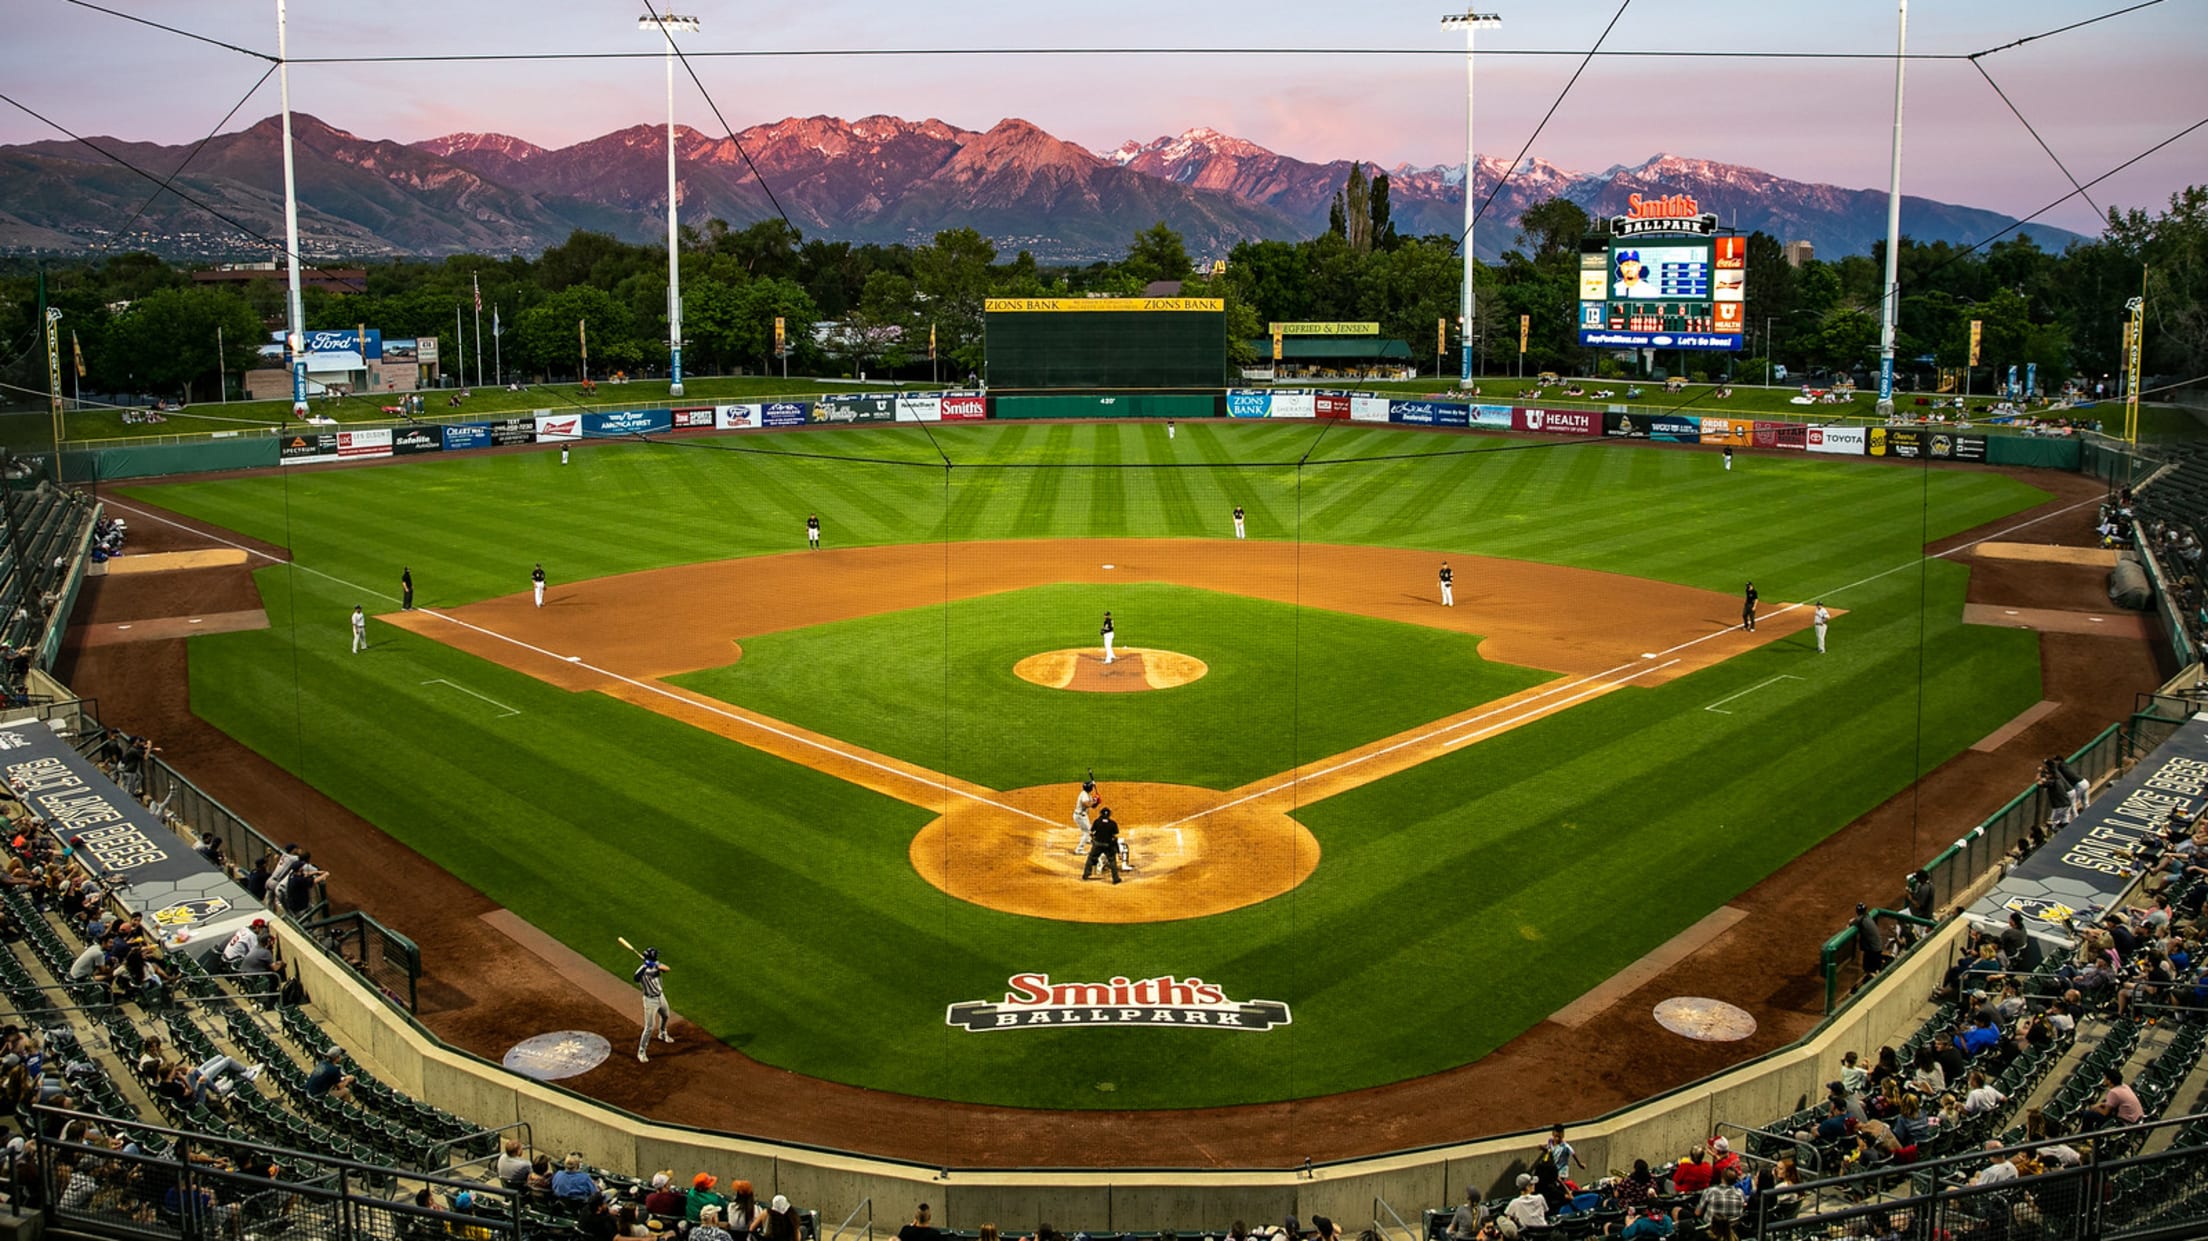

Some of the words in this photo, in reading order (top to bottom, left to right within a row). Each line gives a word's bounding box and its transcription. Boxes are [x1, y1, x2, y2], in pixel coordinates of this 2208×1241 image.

[1627, 193, 1698, 218] Smith's
[1624, 220, 1702, 234] BALLPARK
[986, 300, 1024, 310] ZIONS
[1027, 300, 1060, 310] BANK
[1144, 300, 1181, 310] ZIONS
[1184, 300, 1218, 309] BANK
[1324, 324, 1333, 333] &
[1336, 323, 1370, 333] JENSEN
[311, 332, 352, 350] Ford
[1698, 337, 1709, 346] Go
[1882, 361, 1890, 378] ZONE
[1880, 379, 1888, 399] FORD
[1234, 397, 1264, 405] ZIONS
[943, 401, 984, 416] Smith's
[1234, 405, 1263, 415] BANK
[631, 418, 652, 427] FIRST
[1525, 409, 1544, 429] U
[1546, 414, 1589, 427] HEALTH
[1702, 418, 1729, 428] ORDER
[396, 435, 430, 445] Safelite
[1826, 433, 1863, 444] TOYOTA
[283, 446, 316, 454] SPECTRUM
[37, 786, 125, 830] LAKE
[75, 822, 169, 871] BEES
[1007, 974, 1225, 1005] Smith's
[995, 1009, 1243, 1026] BALLPARK
